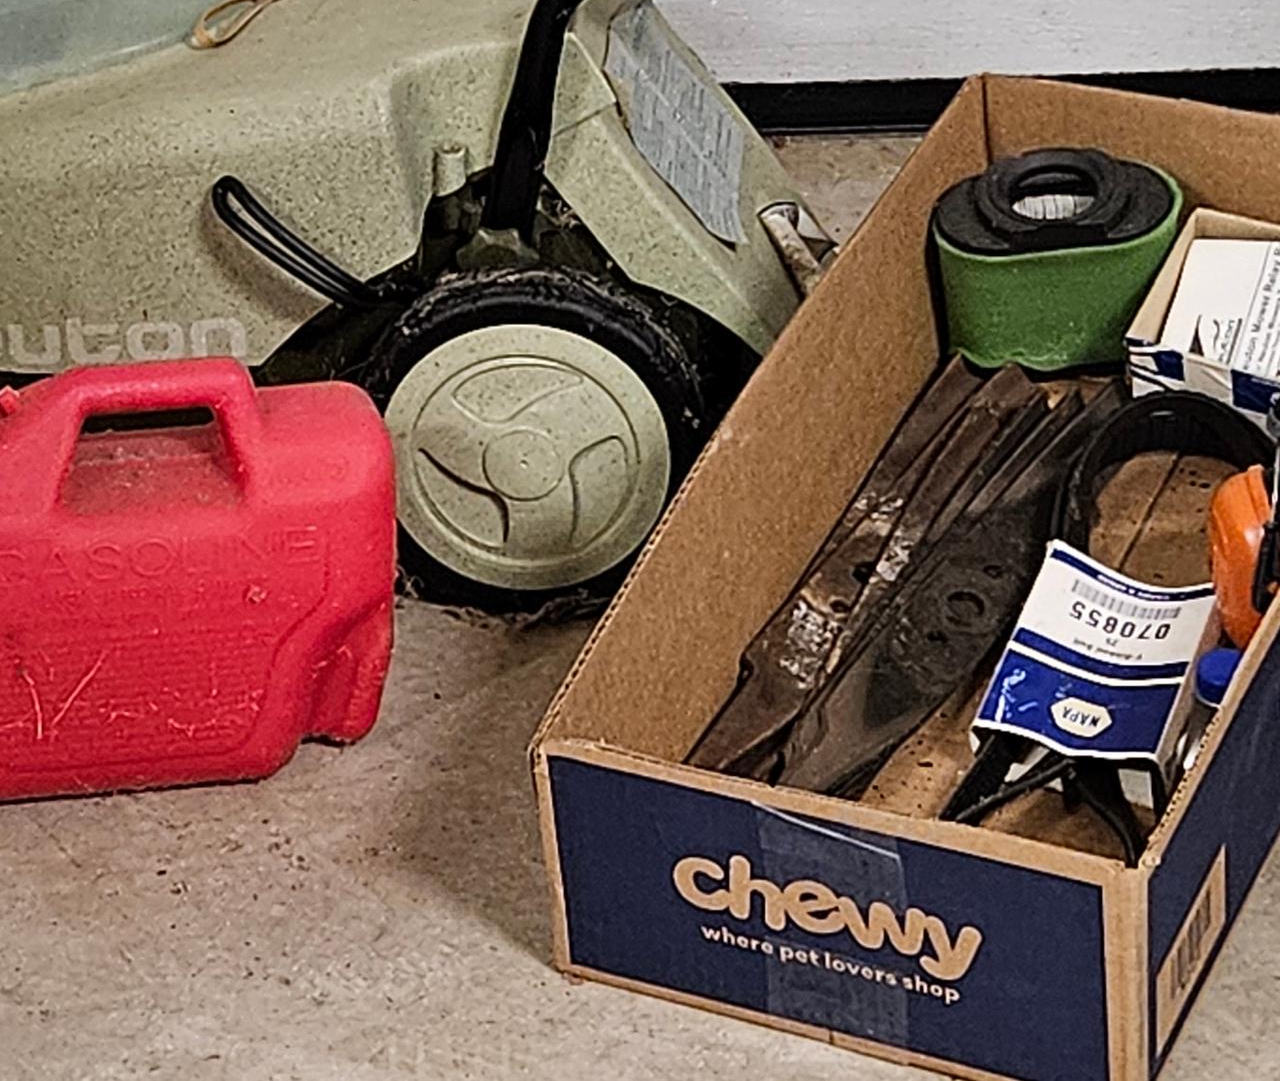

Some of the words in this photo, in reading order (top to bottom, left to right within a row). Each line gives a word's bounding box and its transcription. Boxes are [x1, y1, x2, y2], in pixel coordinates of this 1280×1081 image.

[1251, 295, 1271, 334] Mower
[1070, 600, 1172, 640] 070855
[1061, 705, 1102, 729] NAPA
[672, 854, 983, 981] chewy
[700, 923, 774, 955] where
[778, 944, 821, 968] pet
[824, 952, 899, 987] lovers
[901, 976, 961, 1005] shop
